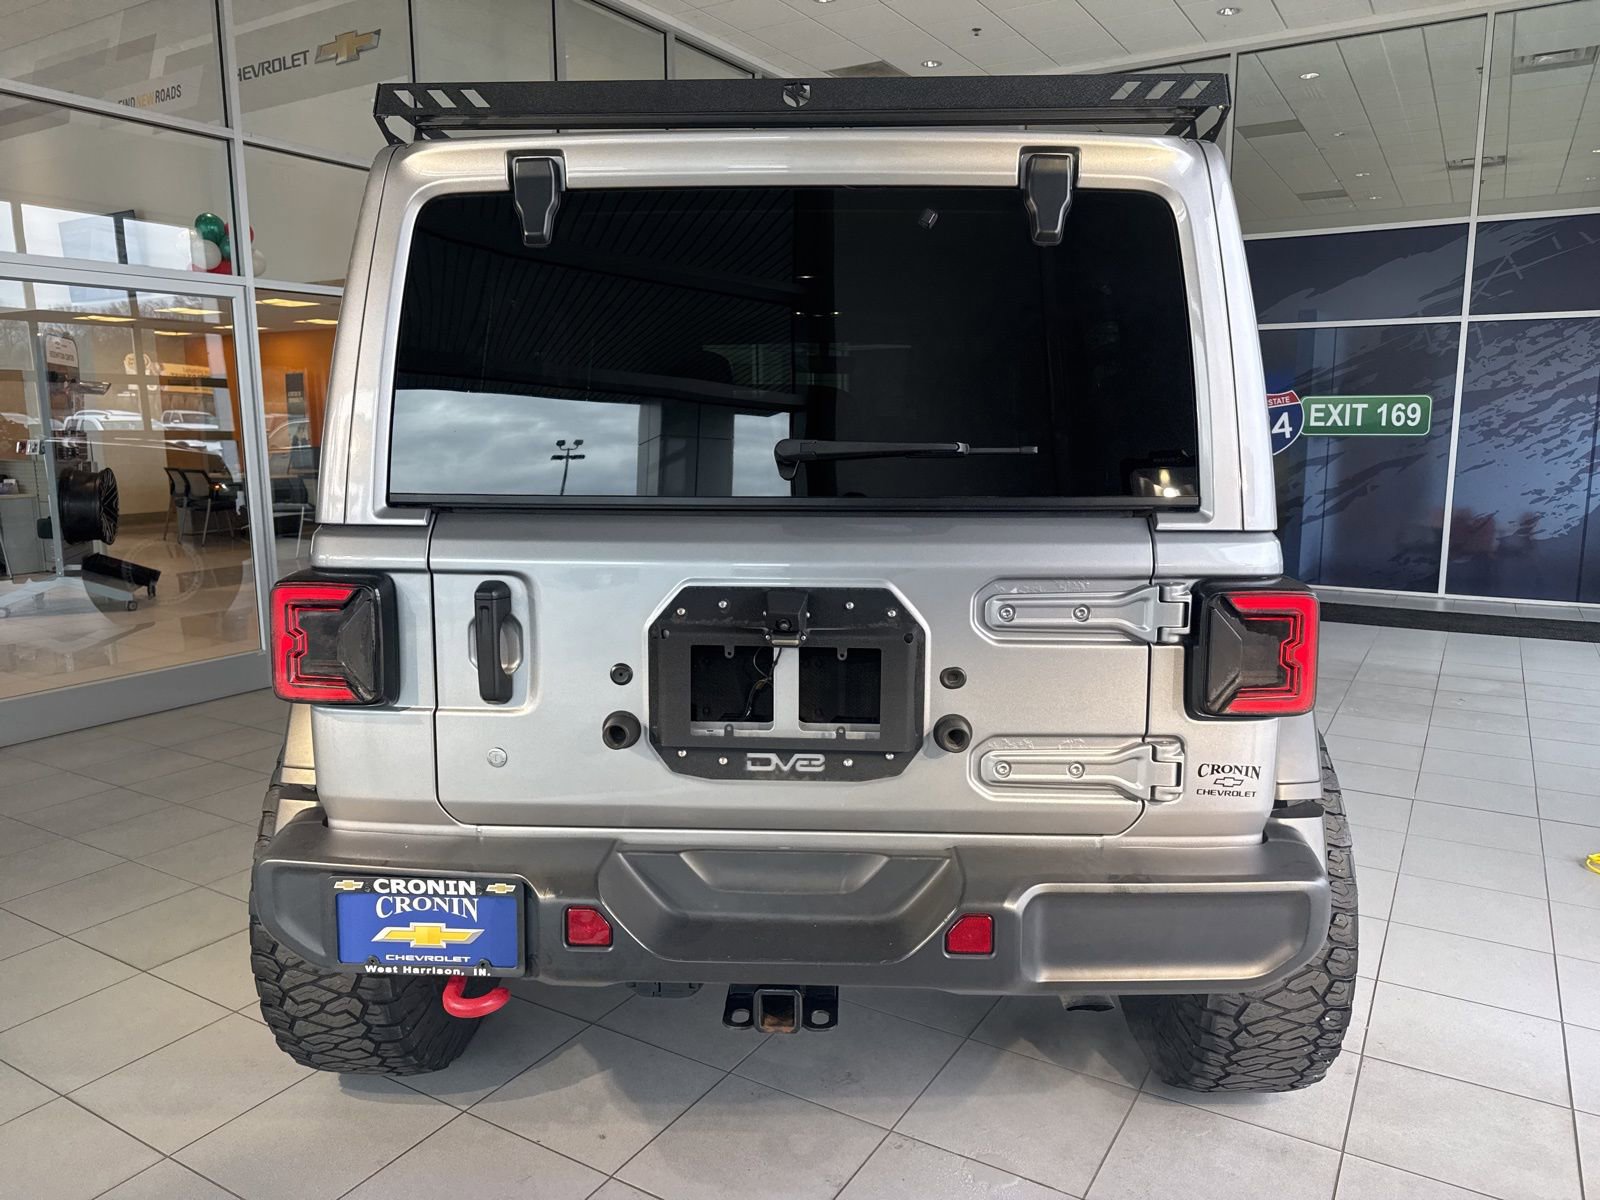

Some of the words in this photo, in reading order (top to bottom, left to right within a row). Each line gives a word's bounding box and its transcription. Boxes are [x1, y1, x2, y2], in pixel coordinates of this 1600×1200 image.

[154, 84, 182, 104] ROADS
[1267, 396, 1290, 405] STATE
[1309, 403, 1369, 427] EXIT
[1376, 402, 1422, 427] 169
[1271, 411, 1293, 439] 4
[1197, 763, 1262, 780] CRONIN
[1196, 788, 1257, 798] CHEVROLET
[372, 878, 477, 896] CRONIN
[375, 895, 479, 923] CRONIN
[385, 954, 472, 963] CHEVROLET
[364, 965, 398, 974] West
[402, 965, 465, 977] Harrison,
[473, 968, 492, 977] IN.
